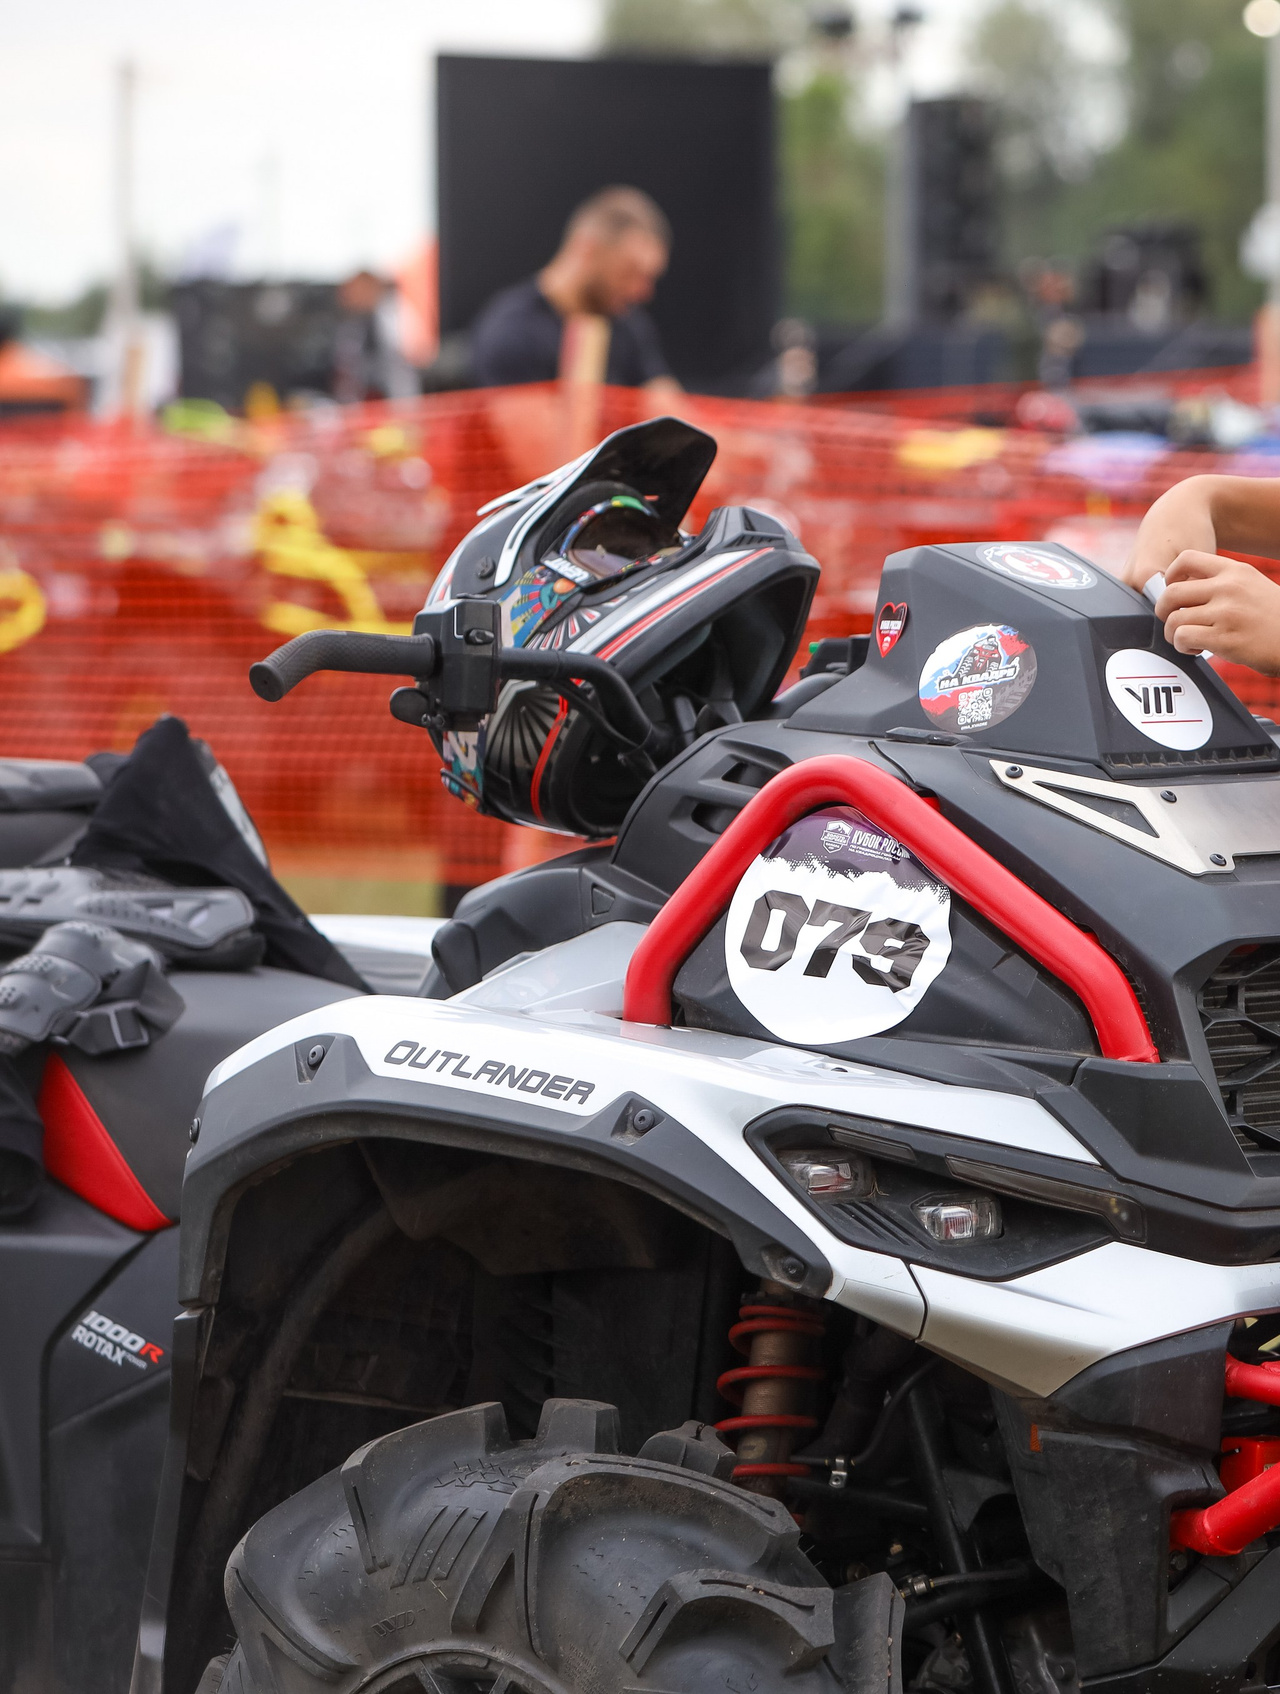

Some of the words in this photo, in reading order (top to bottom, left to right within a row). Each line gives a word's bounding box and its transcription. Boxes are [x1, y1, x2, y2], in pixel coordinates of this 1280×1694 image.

[851, 829, 883, 850] КУБОК
[740, 889, 931, 994] 079
[383, 1040, 596, 1105] OUTLANDER
[71, 1324, 126, 1366] ROTAX
[82, 1310, 164, 1364] 1000R
